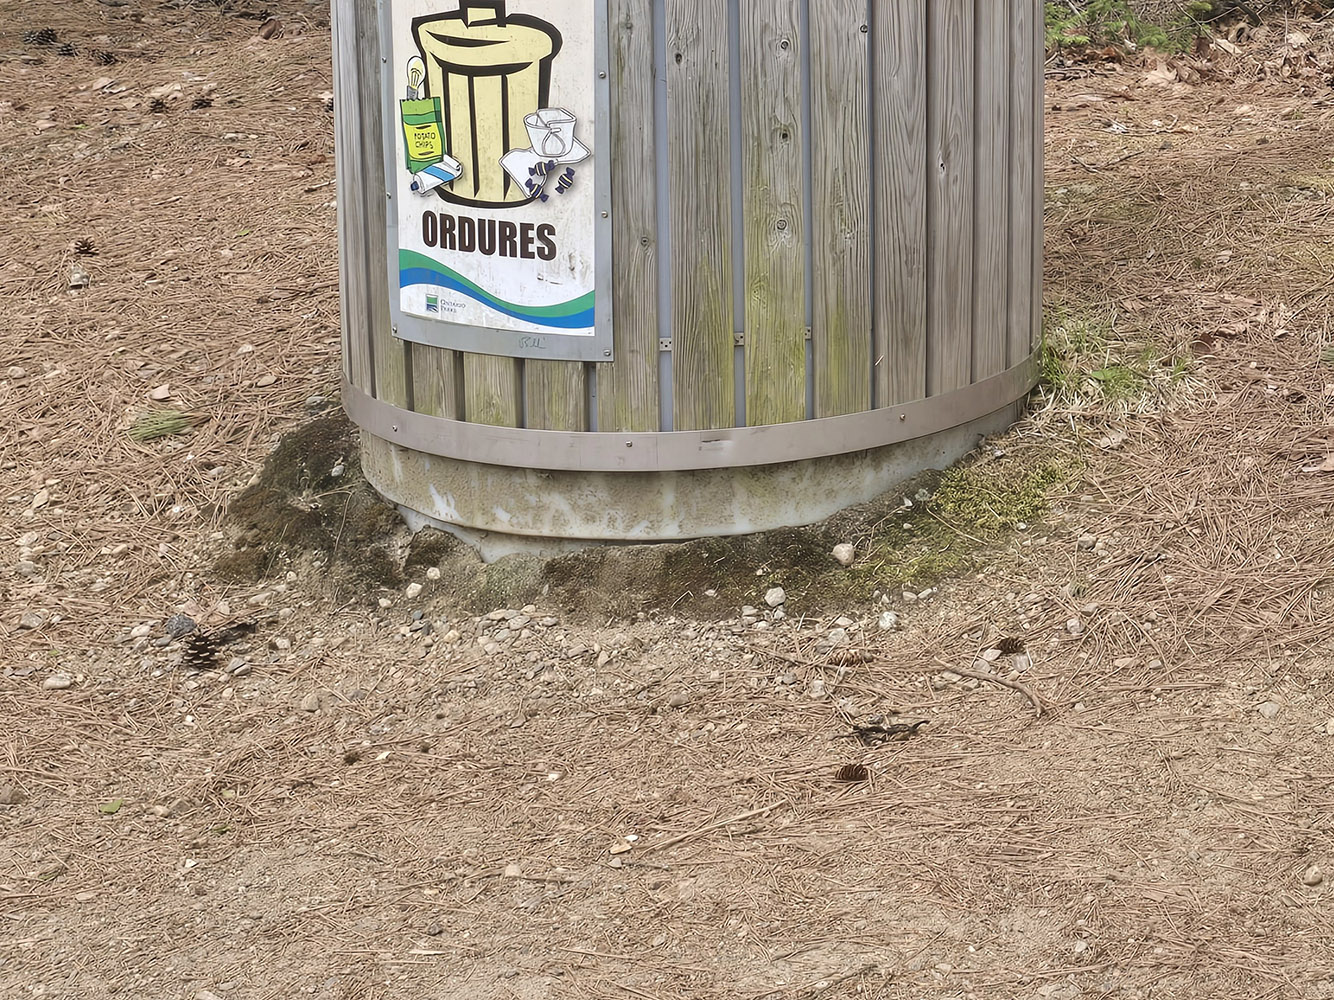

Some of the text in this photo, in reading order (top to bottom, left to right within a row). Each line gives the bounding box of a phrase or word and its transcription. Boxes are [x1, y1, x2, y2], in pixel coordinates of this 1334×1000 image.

[414, 132, 436, 140] POTATO
[415, 141, 434, 150] CHIPS
[422, 210, 557, 262] ORDURES
